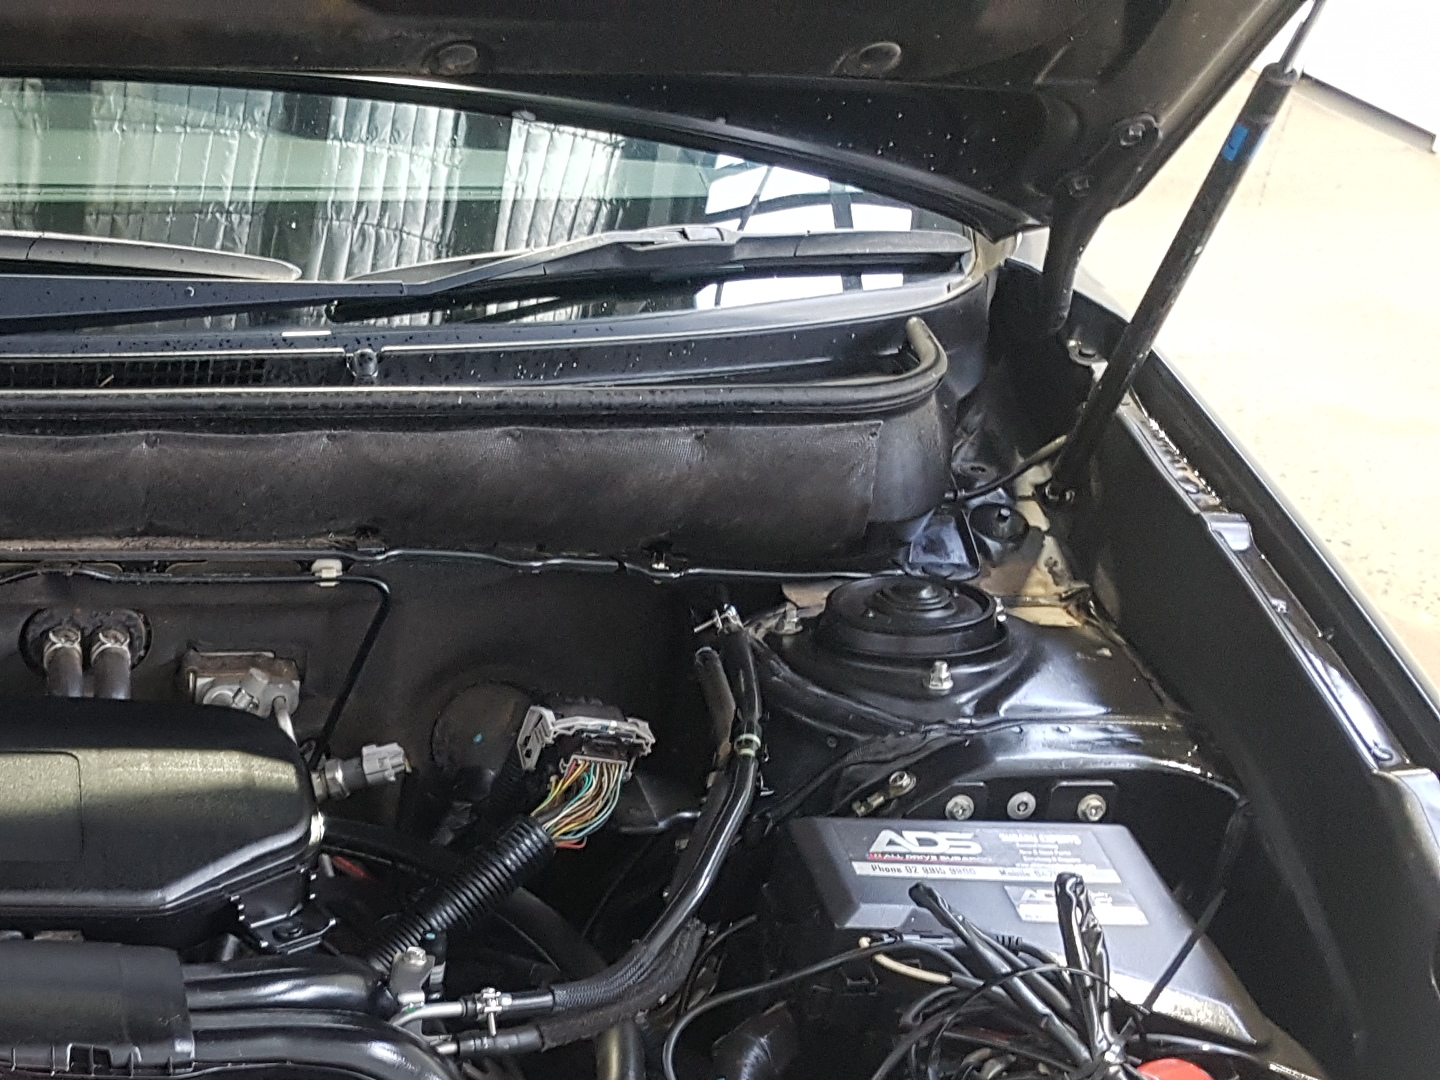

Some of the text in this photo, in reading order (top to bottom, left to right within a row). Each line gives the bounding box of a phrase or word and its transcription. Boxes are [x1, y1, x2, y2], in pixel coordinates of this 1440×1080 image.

[869, 829, 982, 854] ADS
[882, 853, 903, 861] ALL
[871, 863, 903, 874] Phone
[905, 866, 919, 875] 02
